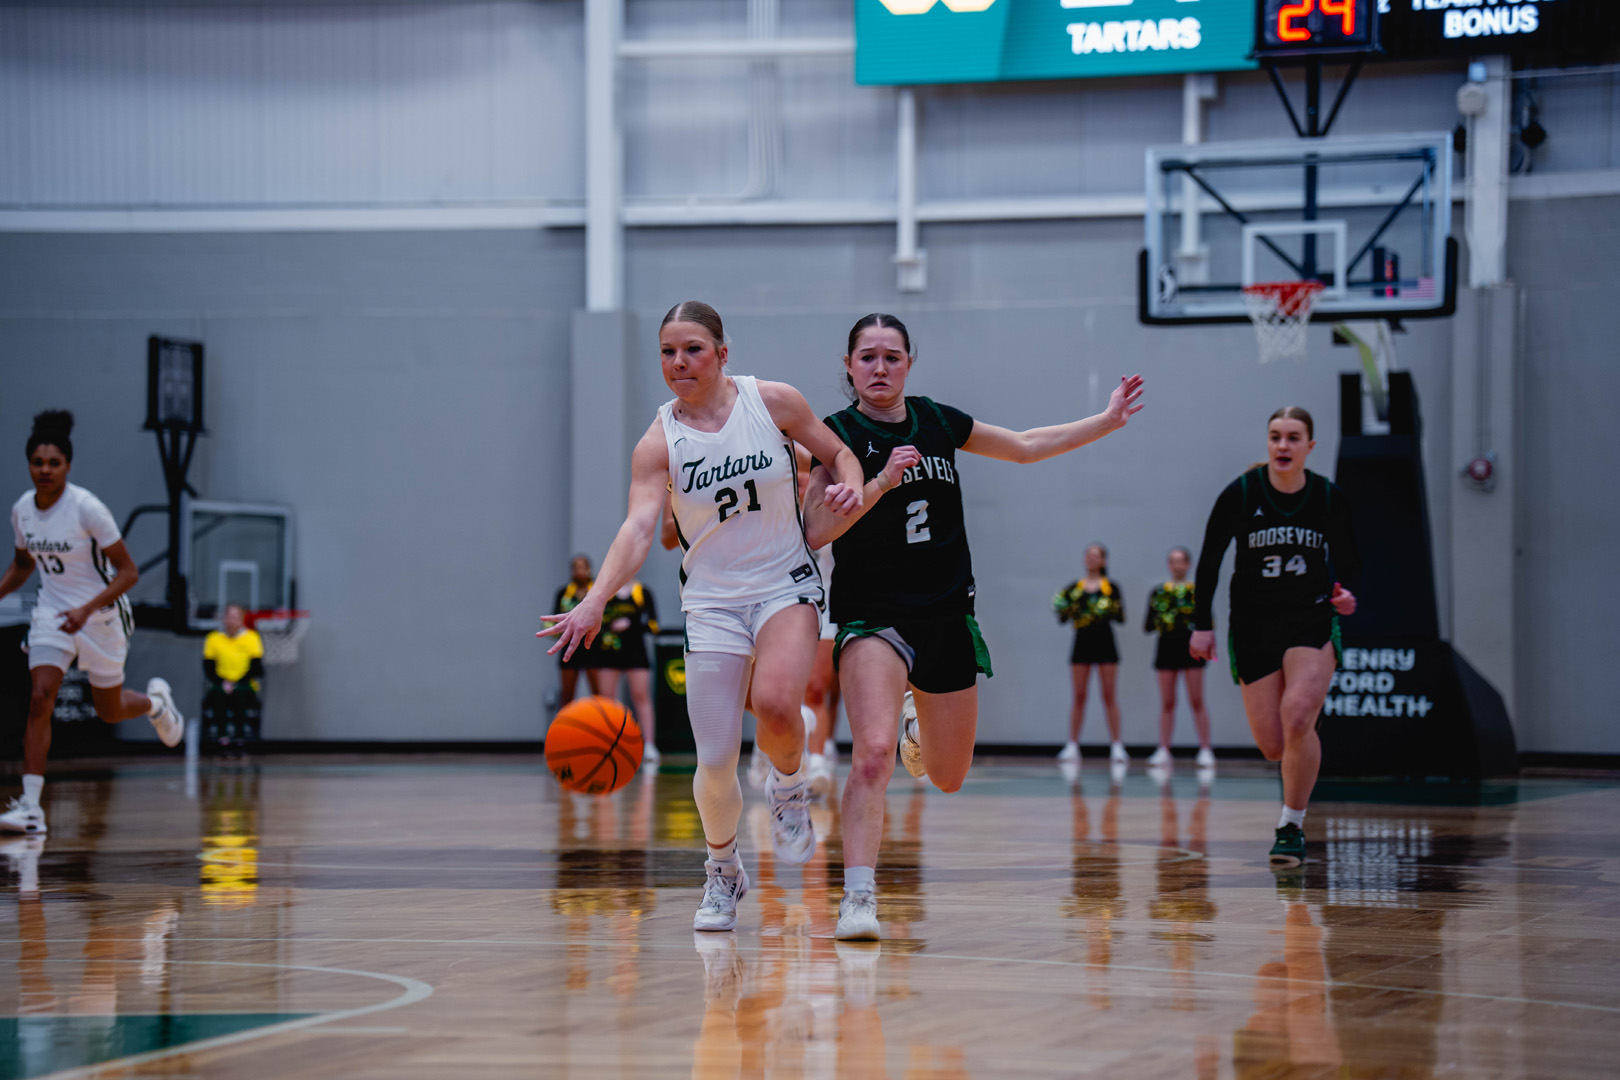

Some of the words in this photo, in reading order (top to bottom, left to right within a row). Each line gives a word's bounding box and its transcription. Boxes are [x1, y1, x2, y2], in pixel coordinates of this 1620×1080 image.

[1067, 17, 1201, 54] TARTARS
[1443, 4, 1540, 38] BONUS
[682, 450, 773, 494] Tartars
[714, 478, 762, 523] 21
[905, 499, 931, 544] 2
[1247, 525, 1324, 549] ROOSEVELT
[1261, 554, 1308, 578] 34
[1342, 647, 1416, 671] ENRY
[1323, 694, 1434, 718] HEALTH
